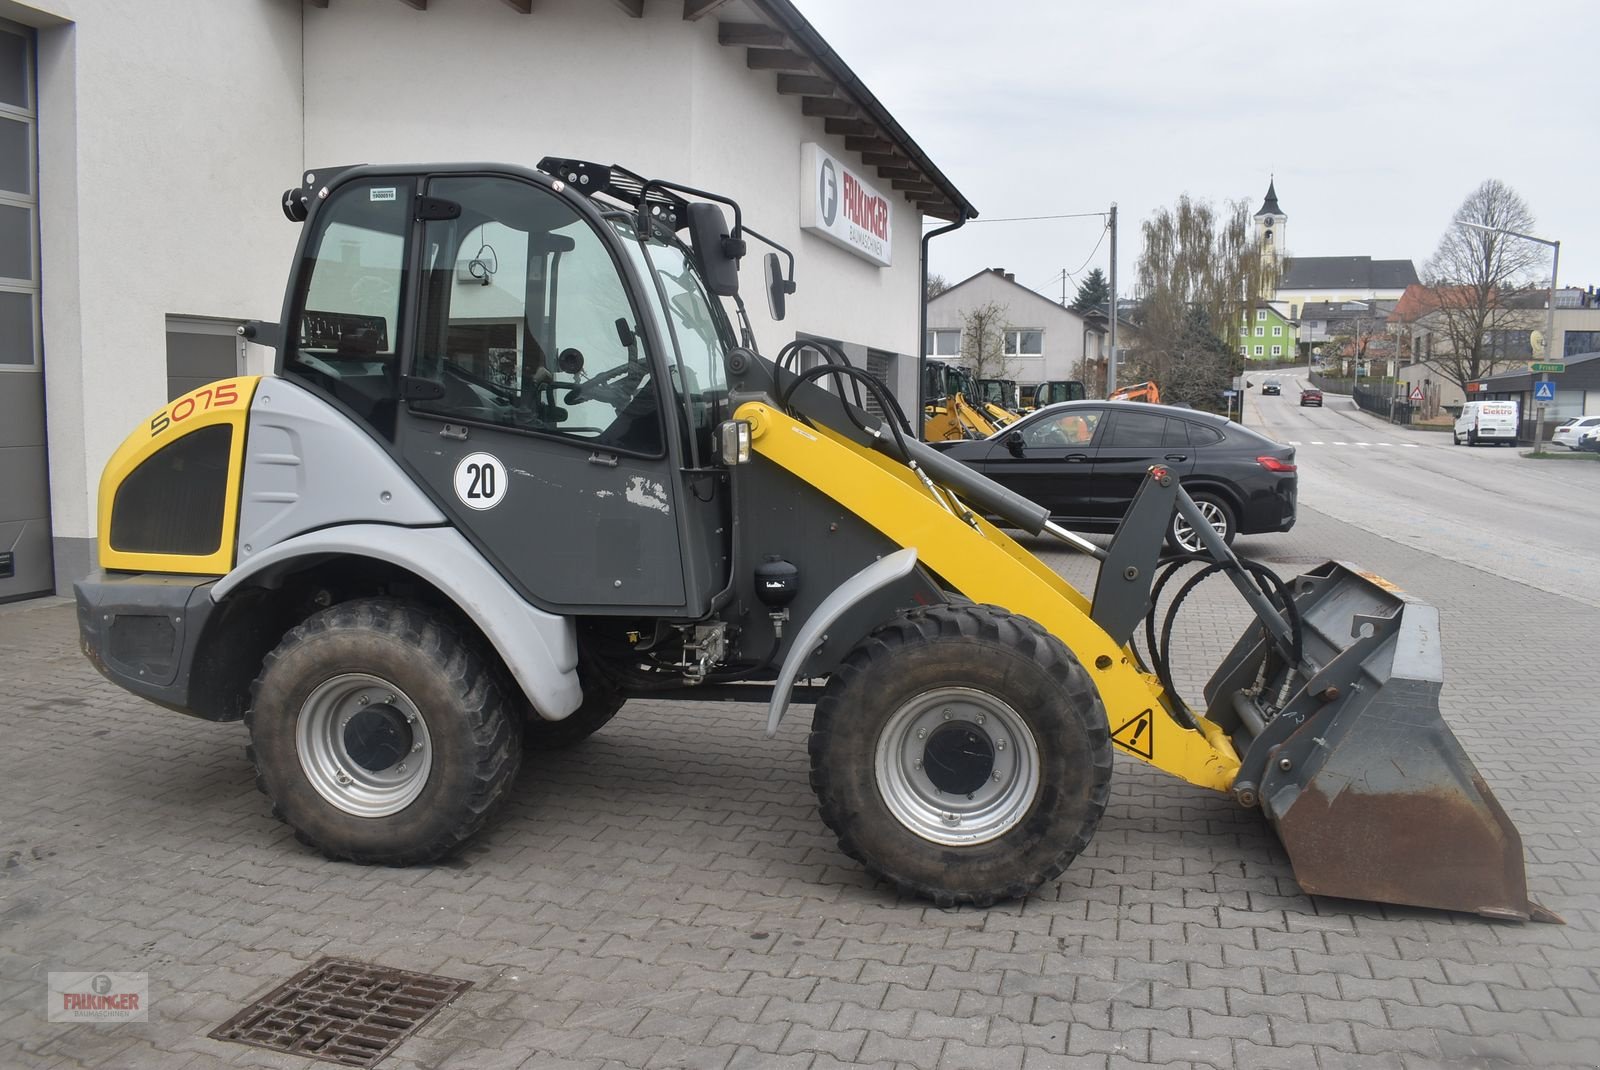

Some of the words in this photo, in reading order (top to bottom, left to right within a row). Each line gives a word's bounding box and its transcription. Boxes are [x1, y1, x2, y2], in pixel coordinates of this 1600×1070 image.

[843, 171, 888, 242] FALKINGER
[849, 225, 883, 257] BAUMASCHINEN
[151, 384, 239, 438] 5075
[1482, 405, 1513, 415] Elektro
[467, 463, 495, 499] 20
